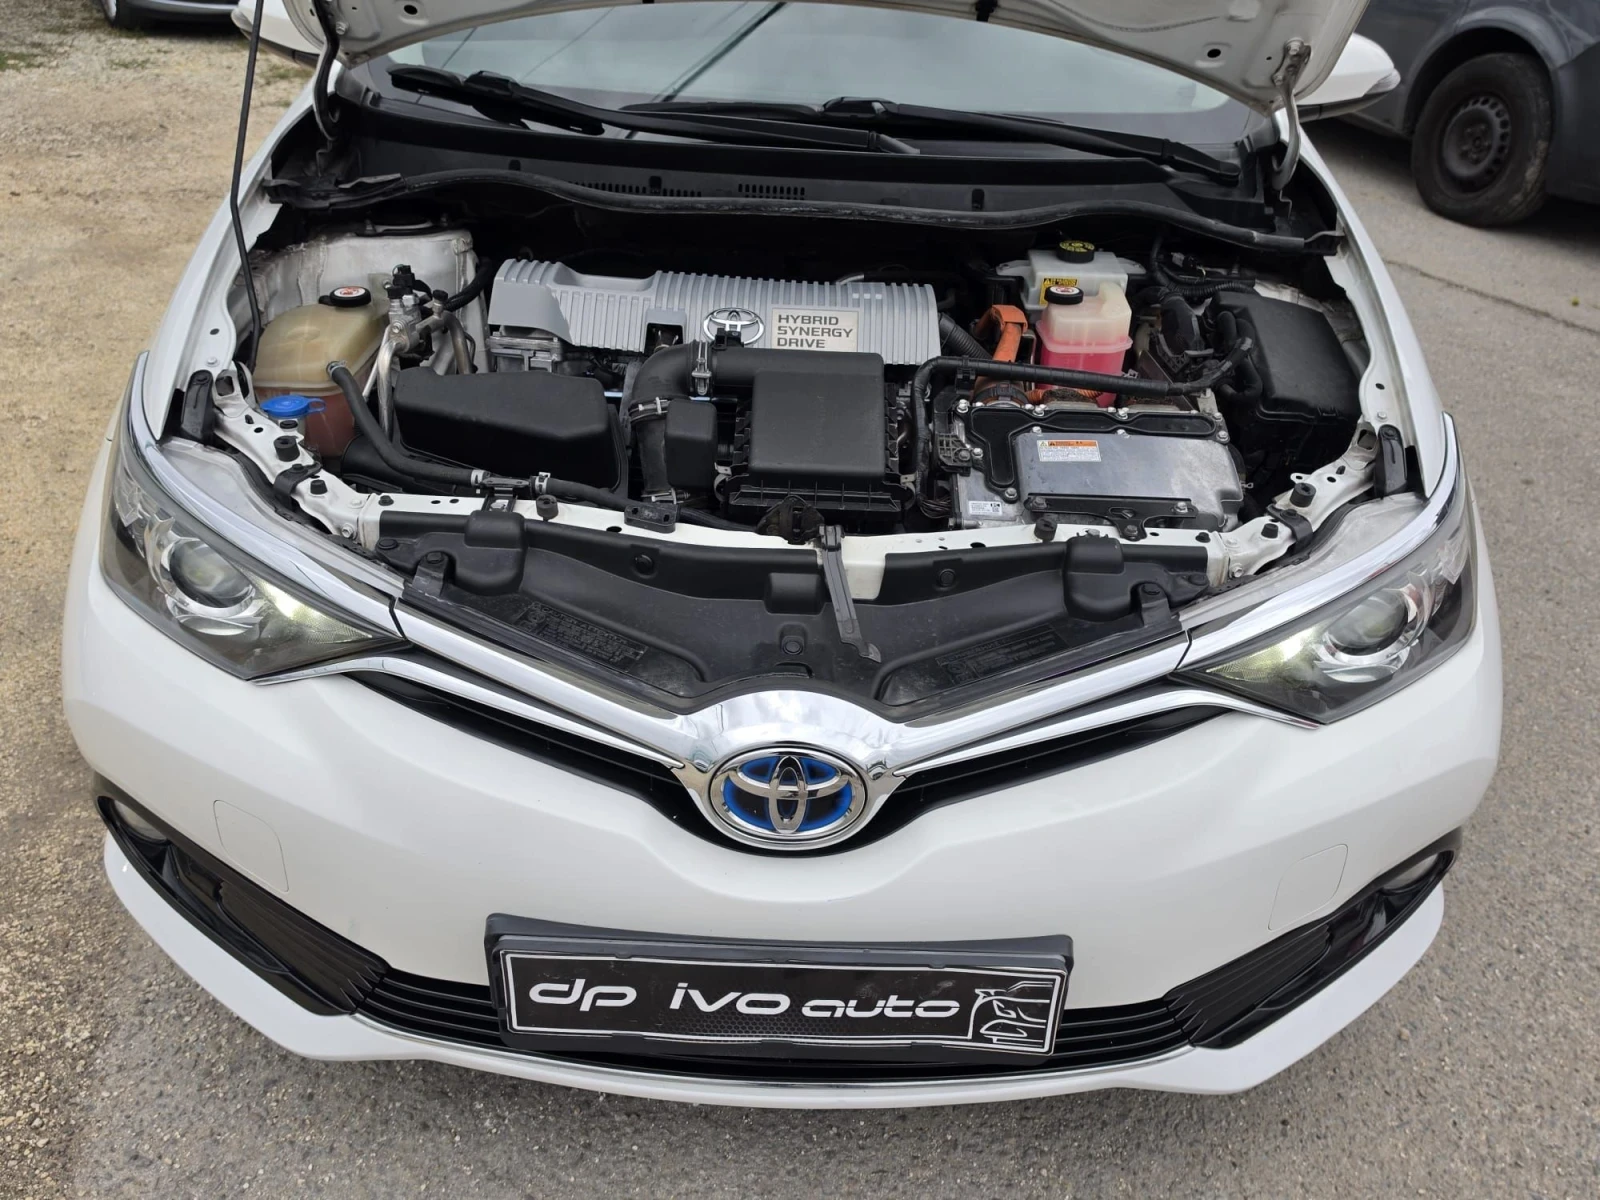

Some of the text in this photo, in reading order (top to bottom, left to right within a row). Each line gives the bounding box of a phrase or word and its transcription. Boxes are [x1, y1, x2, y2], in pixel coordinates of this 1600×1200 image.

[778, 314, 839, 326] HYBRID
[777, 326, 853, 338] SYNERGY
[777, 337, 826, 349] DRIVE
[529, 978, 960, 1018] dp ivo auto
